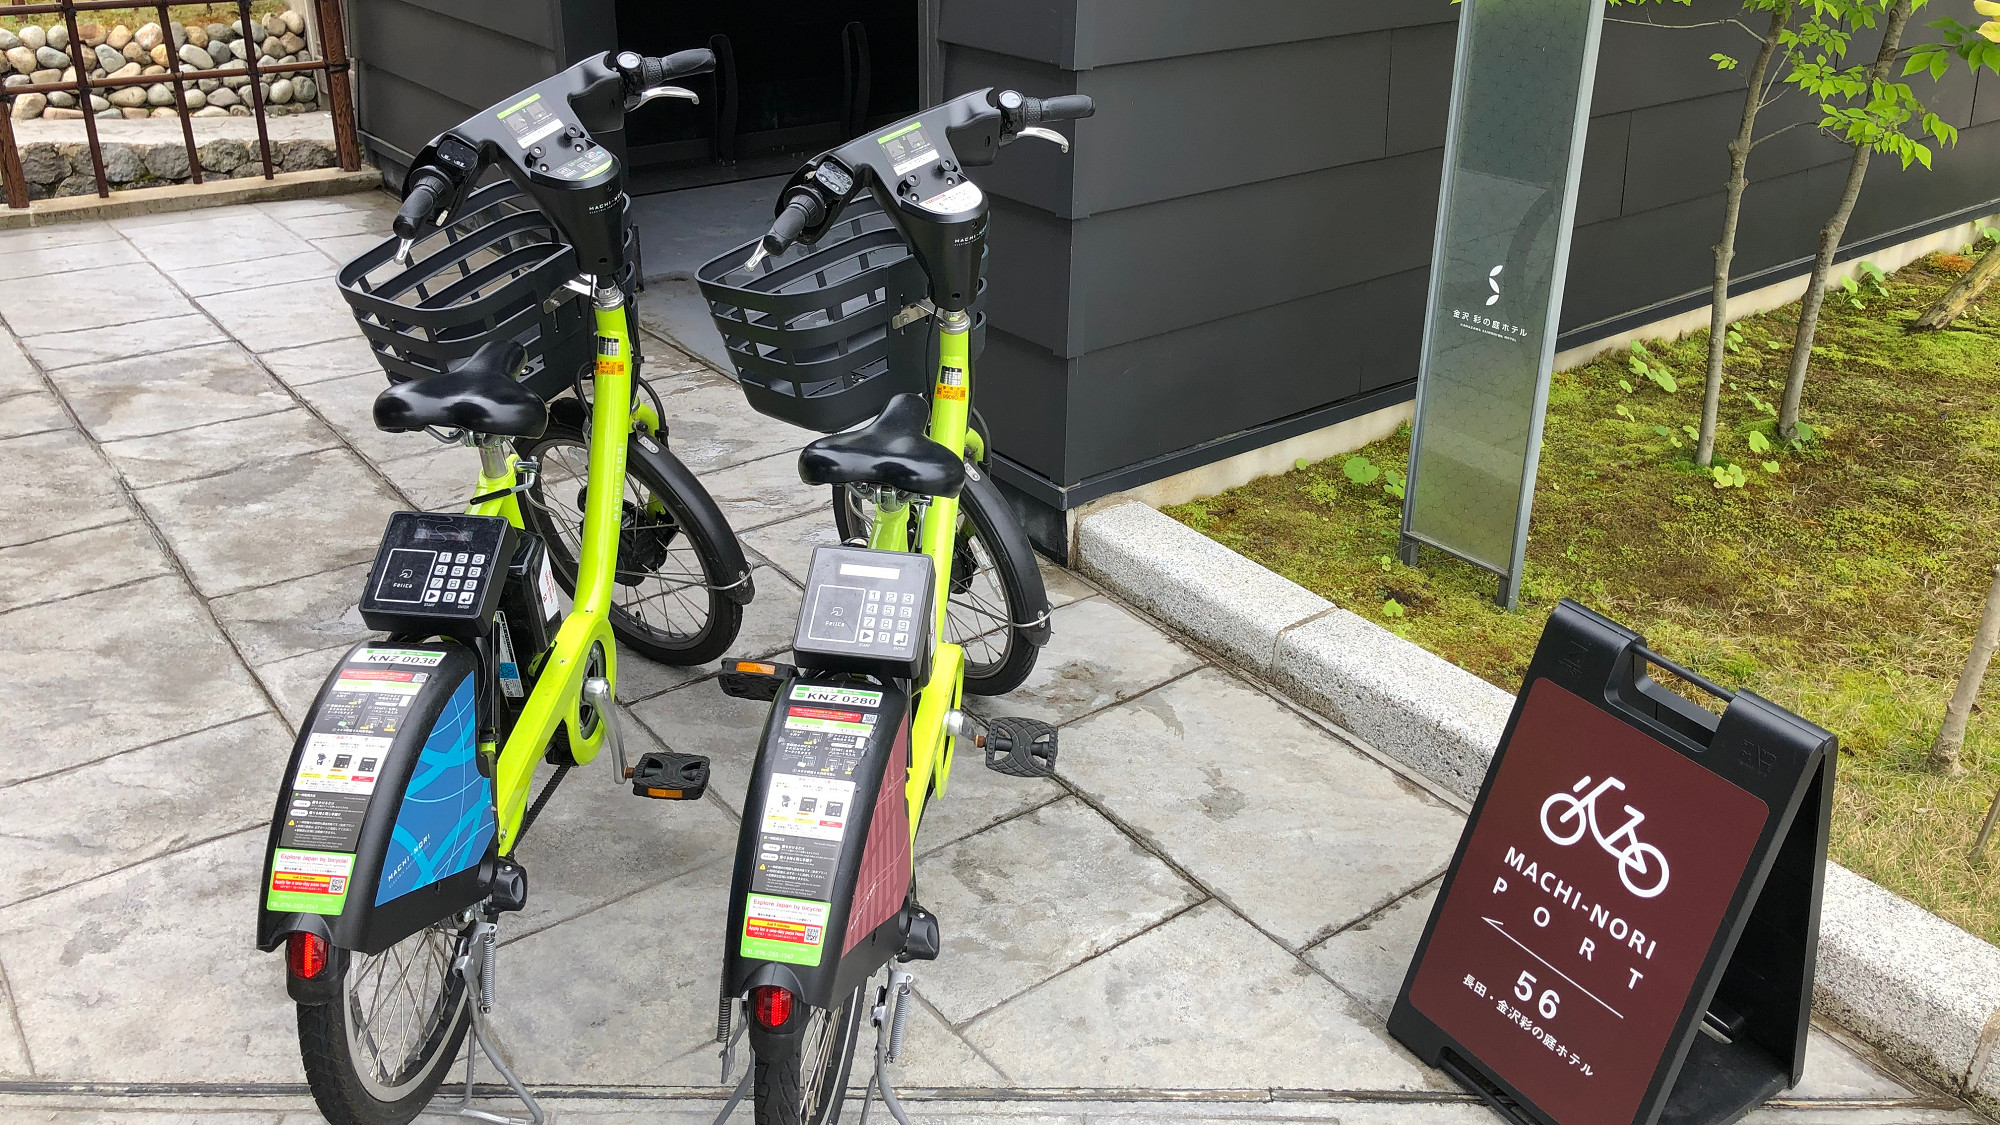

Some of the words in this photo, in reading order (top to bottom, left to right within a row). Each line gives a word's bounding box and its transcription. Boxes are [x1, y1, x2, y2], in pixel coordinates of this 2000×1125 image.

[588, 191, 622, 211] MACHI-N
[954, 225, 987, 243] MACHI-N
[614, 443, 625, 521] MACHI-NORI
[368, 654, 400, 662] KNZ
[402, 656, 437, 665] 0038
[807, 692, 838, 701] KNZ
[842, 695, 877, 705] 0280
[280, 853, 301, 861] Explore
[388, 833, 431, 881] MACHI-NORI
[1504, 846, 1657, 960] MACHI-NORI
[1492, 876, 1644, 989] PORT
[1514, 970, 1561, 1020] 56
[1462, 973, 1594, 1076] 長田・金沢彩の庭ホテル
